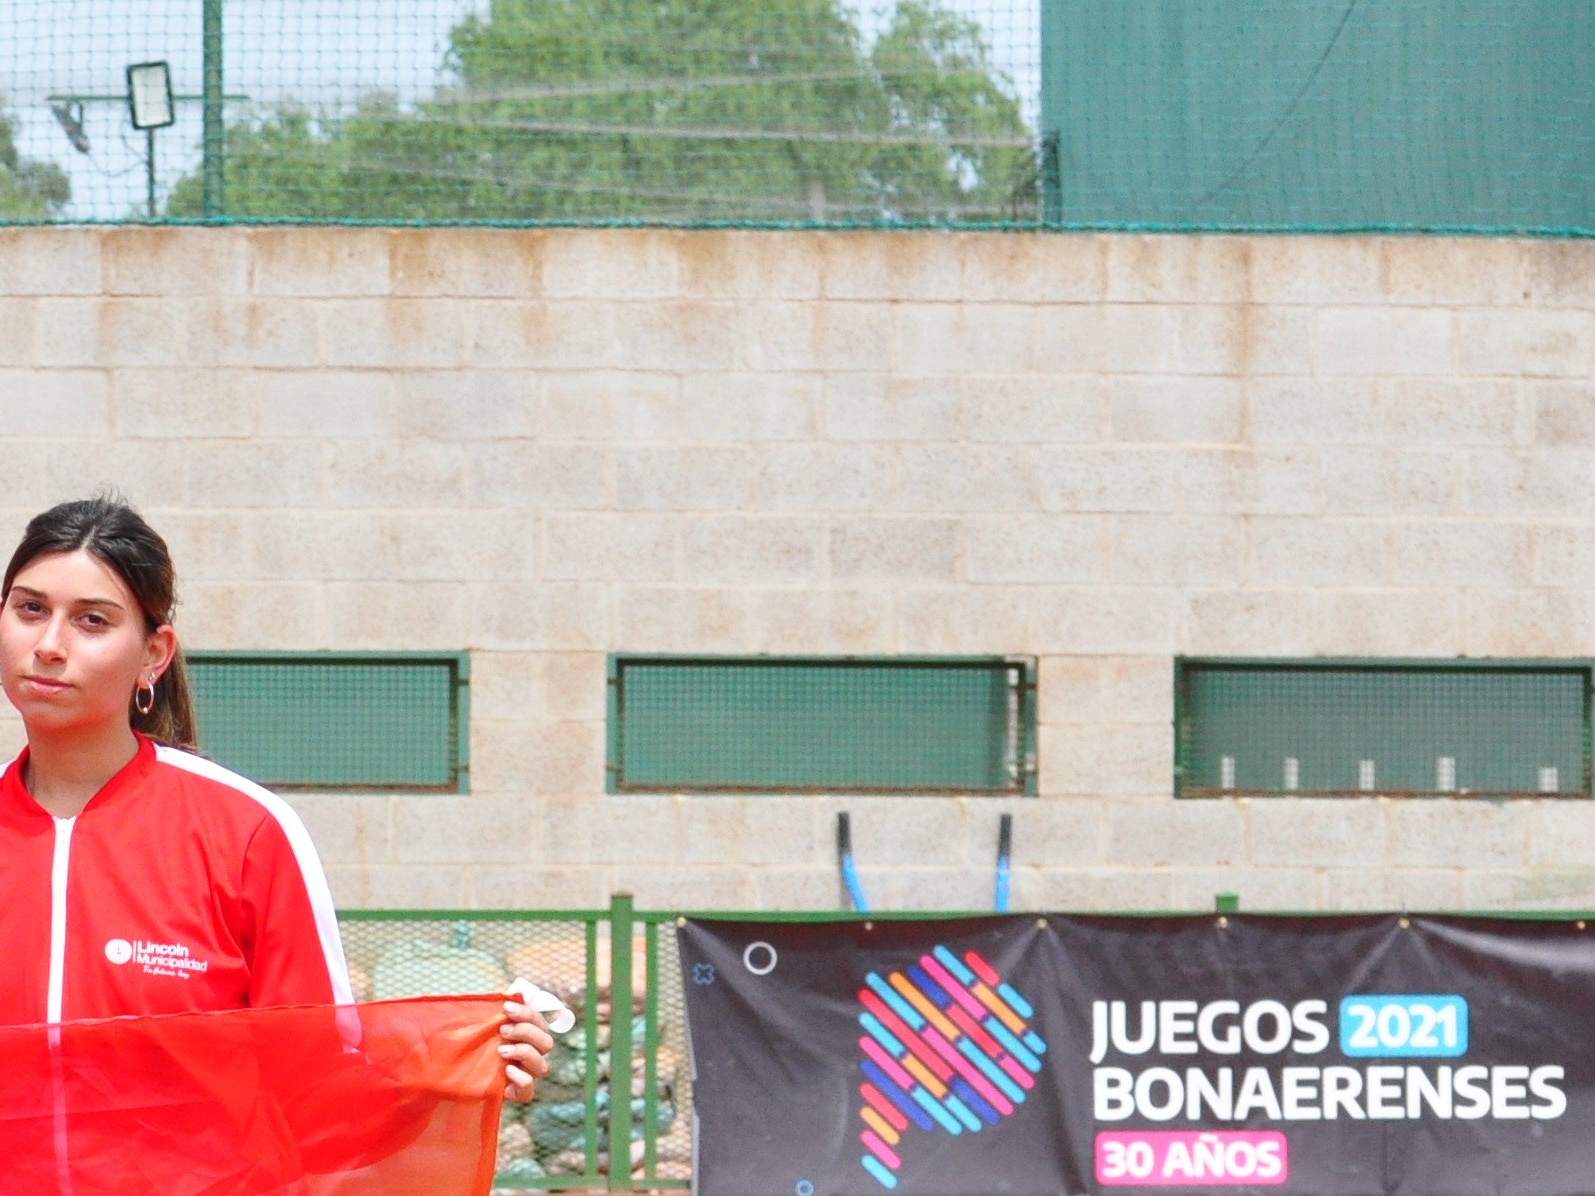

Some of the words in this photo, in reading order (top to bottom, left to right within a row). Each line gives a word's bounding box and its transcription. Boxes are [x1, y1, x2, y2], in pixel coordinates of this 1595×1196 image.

[136, 952, 208, 972] Municipalidad
[137, 940, 190, 958] Lincoln
[1088, 999, 1330, 1065] JUEGOS
[1347, 1004, 1459, 1049] 2021
[1092, 1065, 1568, 1122] BONAERENSES
[1101, 1141, 1154, 1178] 30
[1162, 1134, 1283, 1179] AÑOS
